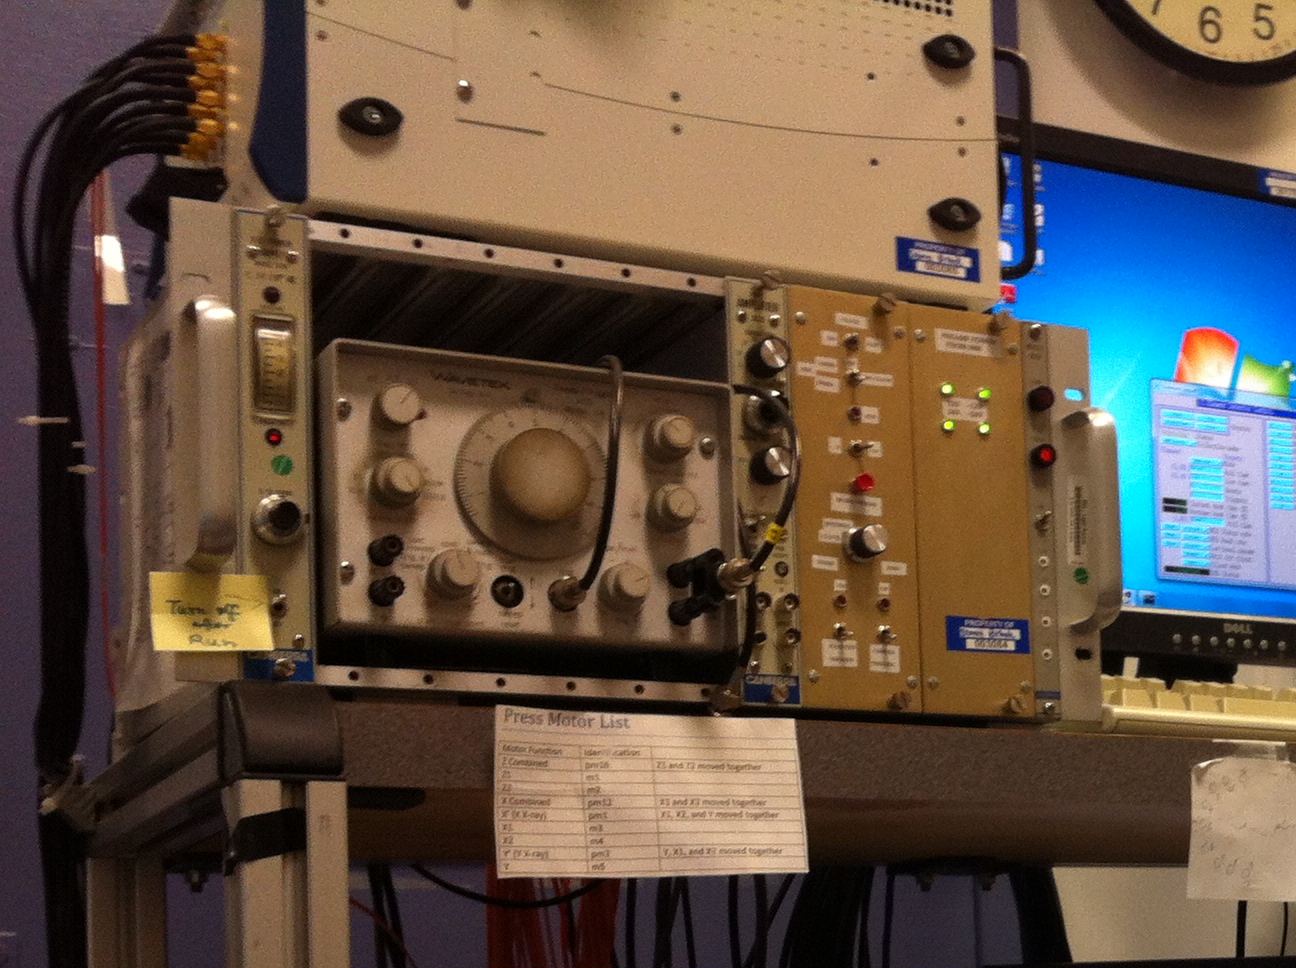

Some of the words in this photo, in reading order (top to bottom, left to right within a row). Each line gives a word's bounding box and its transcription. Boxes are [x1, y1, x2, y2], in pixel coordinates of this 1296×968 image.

[1200, 6, 1223, 44] 6
[1253, 4, 1275, 40] 5
[1223, 622, 1253, 634] DELL
[504, 708, 544, 726] Press
[548, 712, 596, 728] Motor
[600, 718, 631, 729] List
[727, 764, 762, 772] together
[732, 799, 766, 808] together
[746, 812, 779, 820] together
[749, 848, 782, 857] together
